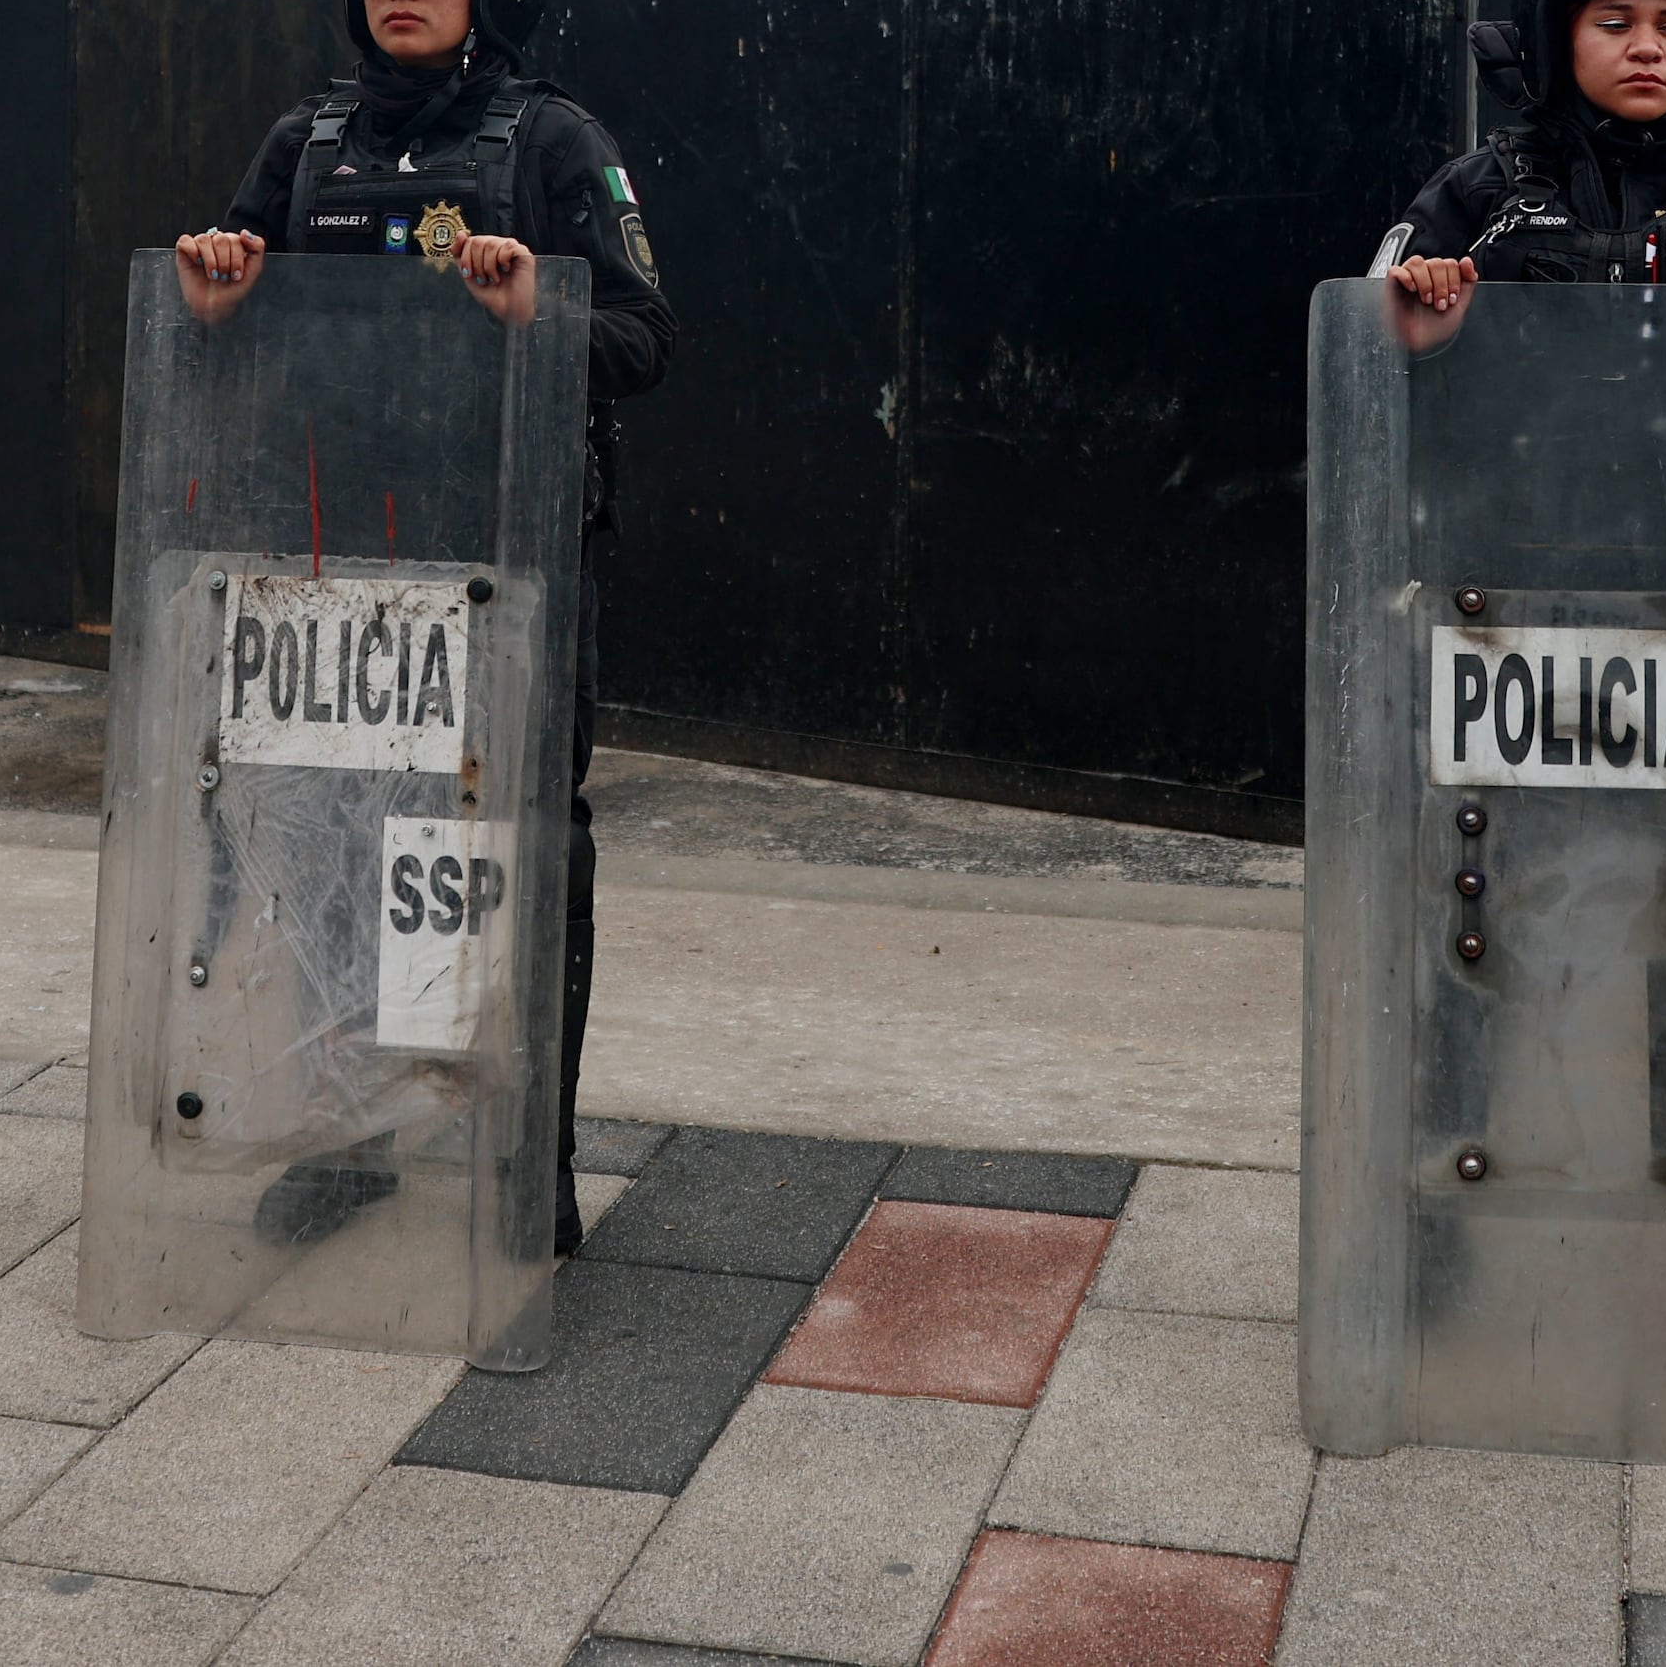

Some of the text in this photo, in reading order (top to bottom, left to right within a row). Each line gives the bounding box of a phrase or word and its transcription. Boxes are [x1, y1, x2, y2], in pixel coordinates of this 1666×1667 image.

[317, 215, 360, 226] GONZALEZ
[1530, 215, 1568, 226] RENDON
[232, 616, 454, 727] POLICIA
[389, 854, 505, 936] SSP
